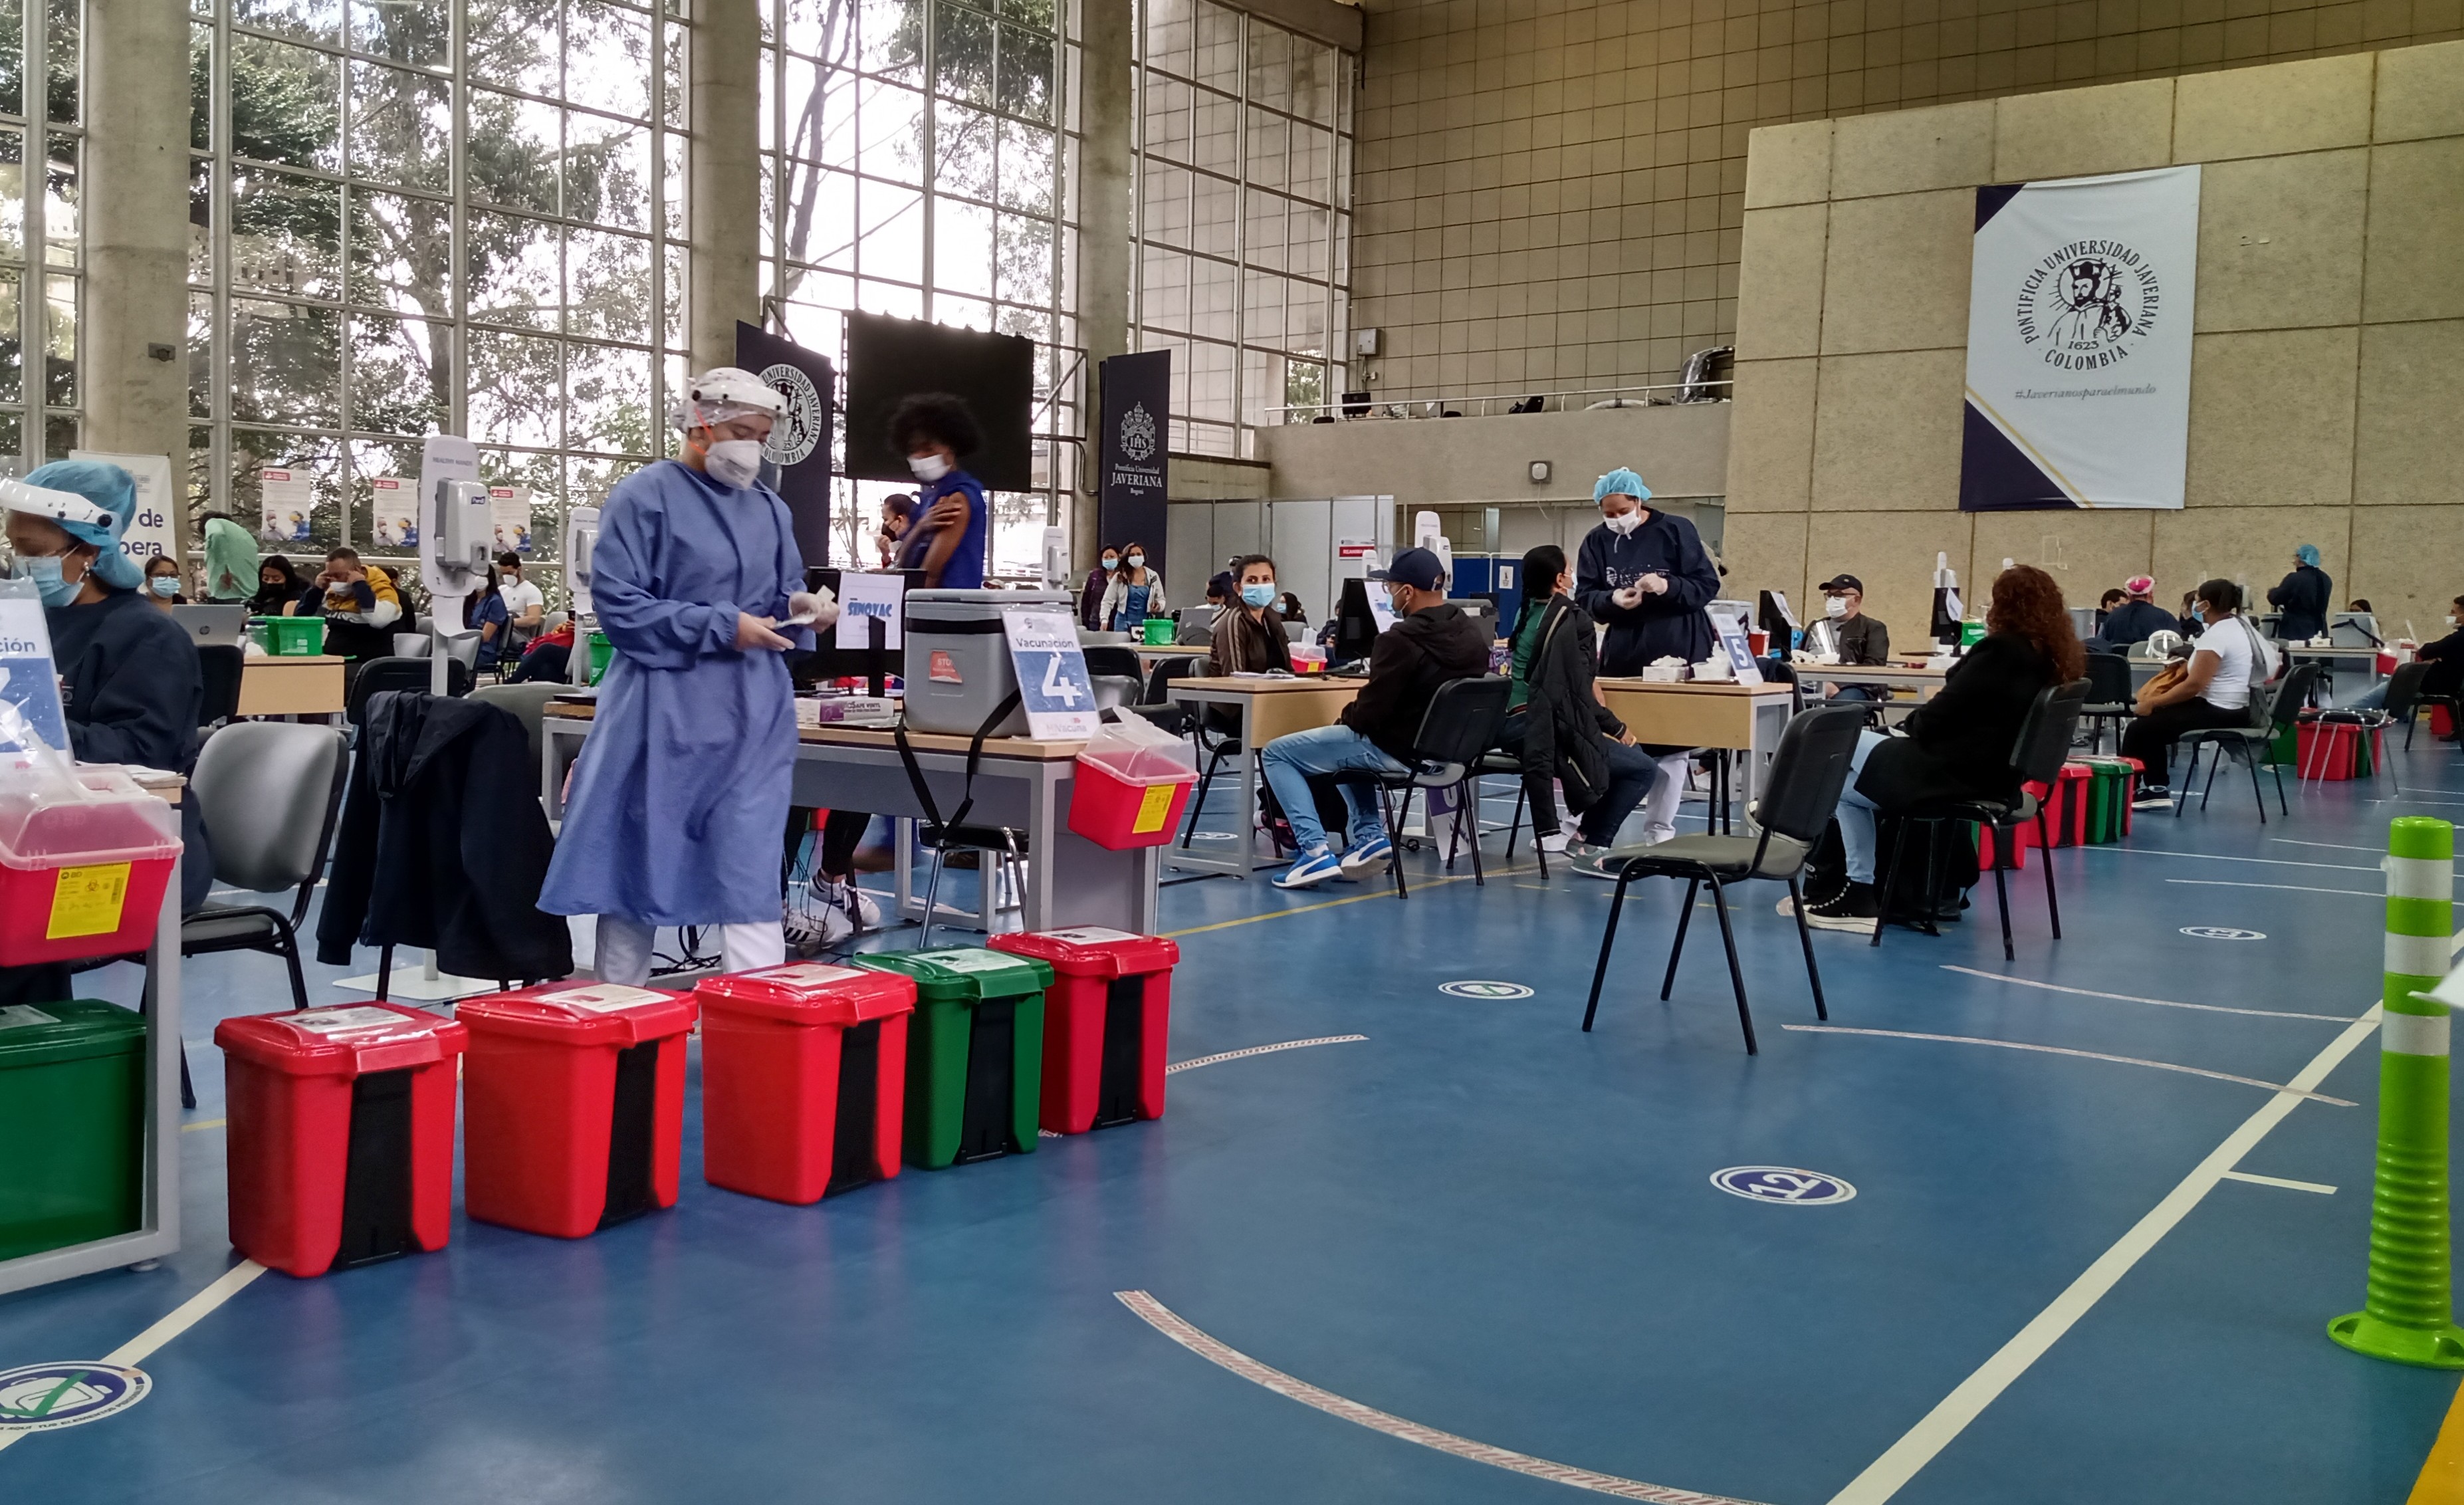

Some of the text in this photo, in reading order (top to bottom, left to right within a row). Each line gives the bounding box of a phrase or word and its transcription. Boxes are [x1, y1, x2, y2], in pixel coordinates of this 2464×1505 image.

[2017, 240, 2160, 344] PONTIFICIA UNIVERSIDAD JAVERIANA
[2068, 340, 2099, 350] 1623
[2045, 345, 2128, 370] COLOMBIA
[764, 368, 820, 445] UNIVERSIDAD JAVERIANA
[1130, 436, 1147, 449] IHS
[764, 447, 806, 464] OLOMBIA
[1111, 472, 1163, 487] JAVERIANA
[138, 508, 164, 528] de
[848, 602, 893, 617] SINOVAC
[1731, 638, 1749, 667] 5
[1042, 656, 1083, 707] 4
[1748, 1173, 1821, 1199] 12
